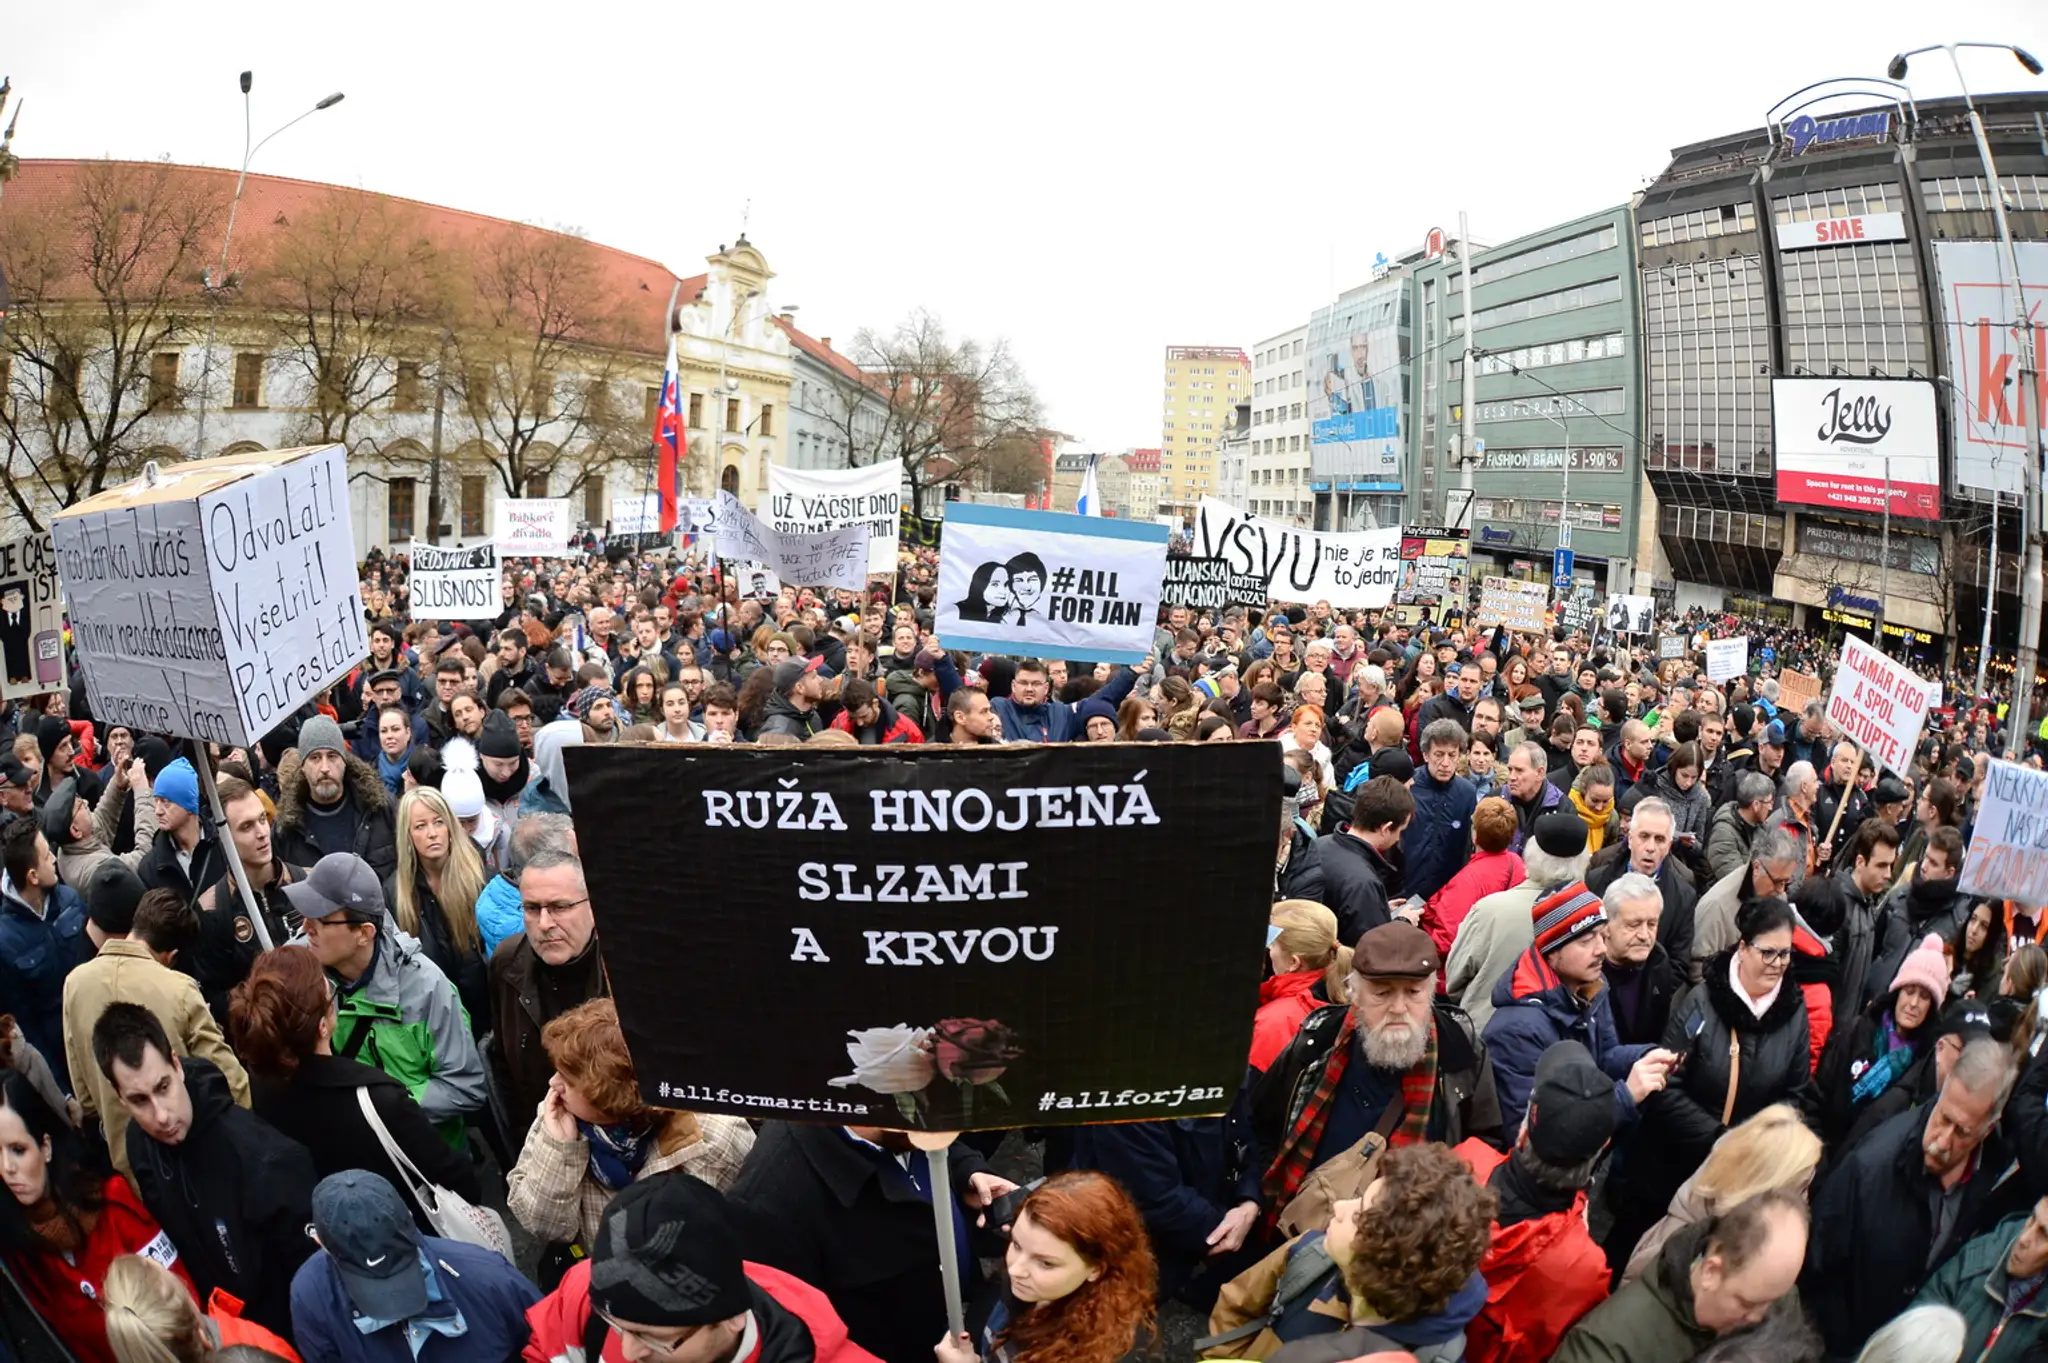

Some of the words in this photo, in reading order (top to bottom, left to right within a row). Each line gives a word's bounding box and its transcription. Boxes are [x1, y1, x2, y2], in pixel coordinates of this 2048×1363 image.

[1815, 218, 1865, 242] SME
[1817, 387, 1892, 445] Jelly
[1486, 453, 1528, 467] FASHION
[772, 493, 794, 519] UŽ
[801, 493, 865, 519] VÄČŠIE
[869, 492, 898, 515] DNO
[1805, 479, 1829, 489] Spaces
[1830, 481, 1840, 489] for
[1841, 483, 1855, 491] rent
[1863, 485, 1876, 493] this
[1877, 487, 1908, 498] prperty
[210, 460, 336, 573] Odvolať!
[1403, 526, 1443, 537] PlayStation
[126, 503, 190, 579] Judáš
[806, 553, 822, 566] TO
[826, 542, 863, 560] THE
[1200, 506, 1322, 592] VŠVU
[1325, 543, 1349, 561] nie
[1353, 546, 1375, 567] je
[1382, 541, 1400, 560] ná
[1806, 526, 1848, 541] PRIESTORY
[1849, 534, 1862, 543] NA
[1863, 535, 1908, 550] PRENJOM
[480, 546, 491, 568] SI
[791, 563, 846, 584] Future
[413, 572, 495, 607] SLUŠNOSŤ
[1052, 566, 1119, 598] #ALL
[1334, 565, 1352, 585] to
[217, 540, 329, 655] Vyšetriť!
[1048, 595, 1094, 623] FOR
[1098, 600, 1142, 627] JAN
[1480, 612, 1544, 629] DEMKRACIU
[236, 595, 364, 732] Potrestať!
[1845, 646, 1895, 693] KLAMÁR
[1894, 678, 1925, 714] FICO
[162, 669, 232, 744] Vám
[1853, 681, 1864, 702] A
[1864, 687, 1896, 728] SPOL.
[1830, 695, 1899, 766] ODSTÚPTE
[1897, 747, 1908, 772] !
[701, 777, 848, 832] RUŽA
[870, 768, 1161, 833] HNOJENÁ
[797, 860, 1030, 903] SLZAMI
[790, 926, 831, 964] A
[864, 924, 1060, 966] KRVOU
[658, 1080, 870, 1115] #allformartina
[1037, 1081, 1226, 1115] #allforjan
[658, 1262, 721, 1306] 365
